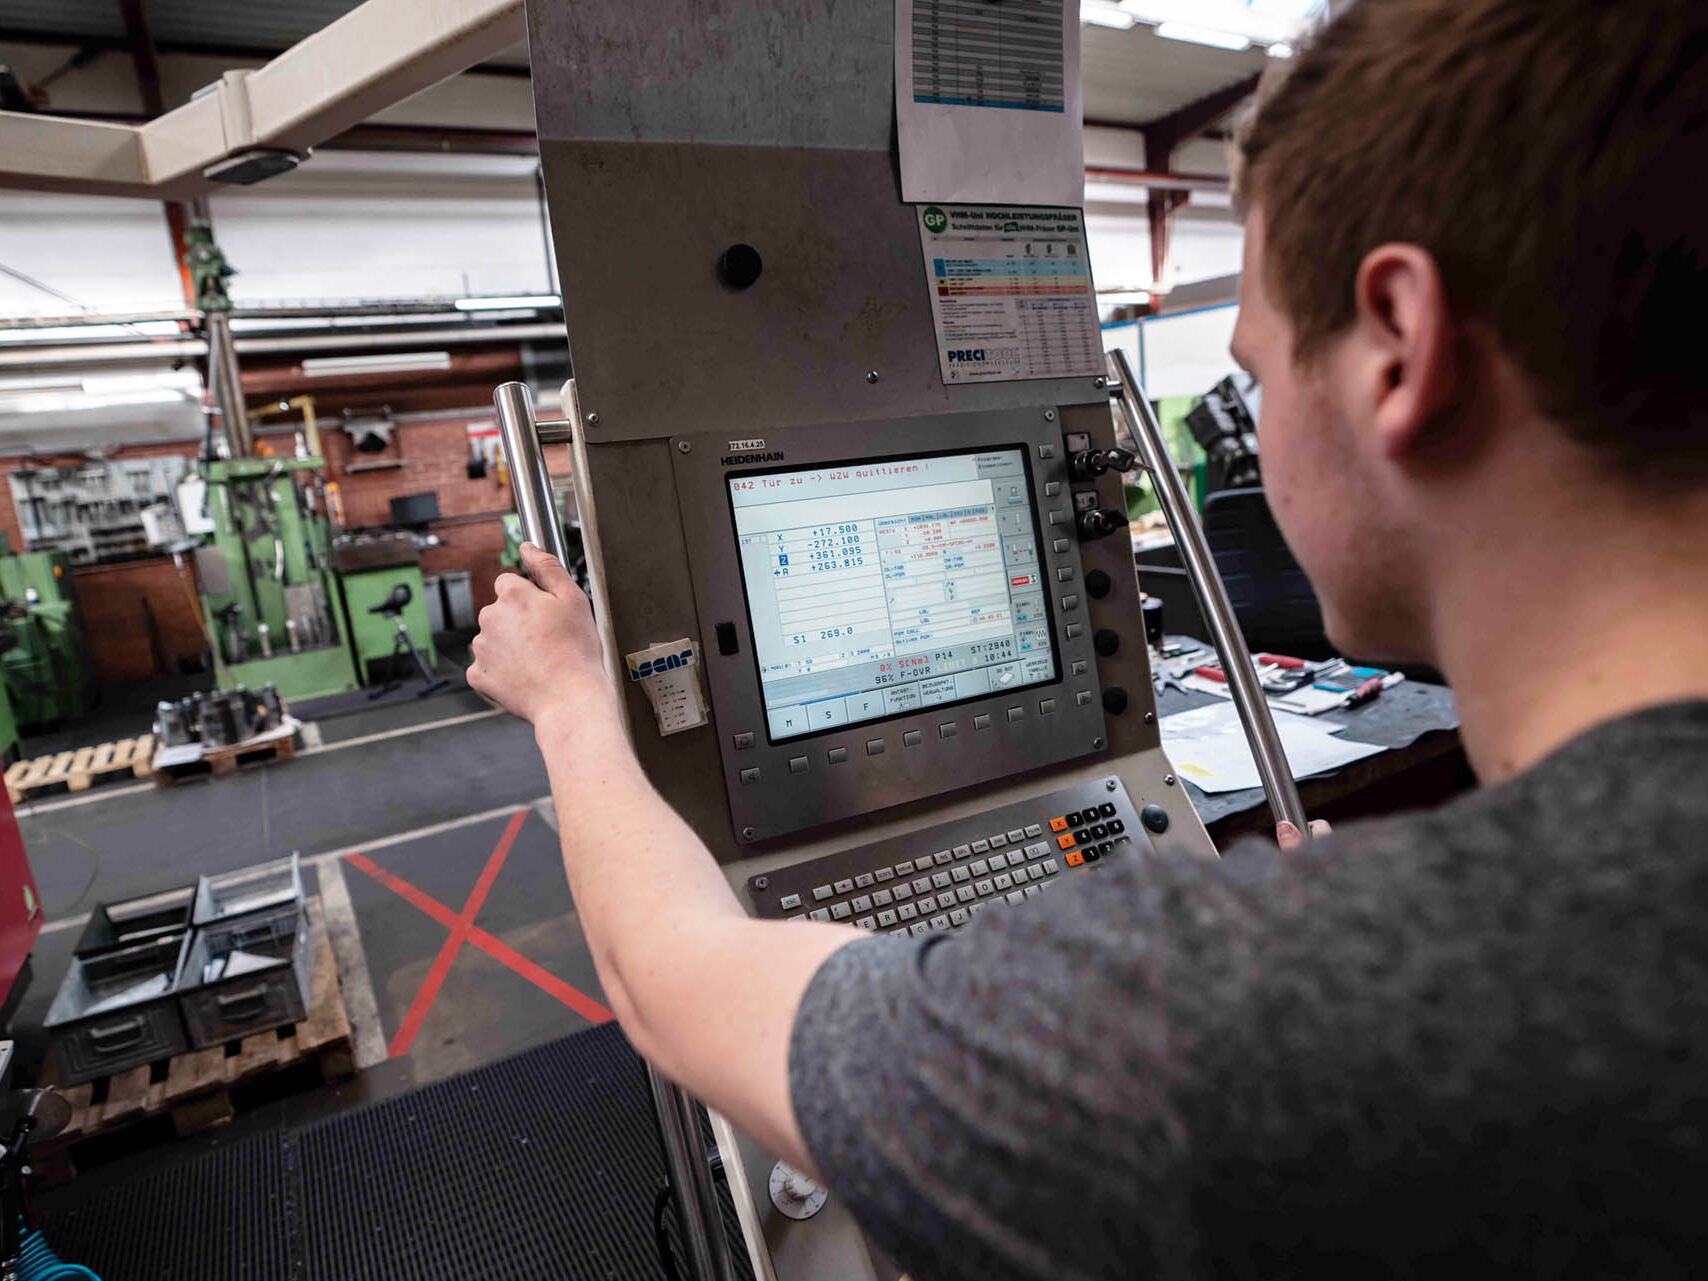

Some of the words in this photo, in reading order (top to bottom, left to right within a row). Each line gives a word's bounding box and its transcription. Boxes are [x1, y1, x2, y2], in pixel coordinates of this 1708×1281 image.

[925, 214, 946, 227] GP
[721, 452, 784, 466] HEIDENHAIN
[733, 481, 755, 491] 042
[790, 478, 803, 486] zu
[856, 465, 919, 478] quittieren
[813, 524, 858, 537] +17.500
[808, 535, 860, 549] -272.100
[810, 546, 862, 560] +361.095
[811, 557, 863, 571] +263.815
[793, 635, 806, 644] S1
[820, 626, 853, 640] 269.0
[880, 664, 892, 672] 0%
[935, 651, 953, 661] P14
[970, 639, 1011, 654] ST:2940
[875, 673, 894, 684] 96%
[900, 666, 931, 678] F-OVR
[985, 650, 1012, 662] 10:44
[863, 703, 869, 711] F
[825, 711, 832, 719] S
[786, 719, 793, 727] M
